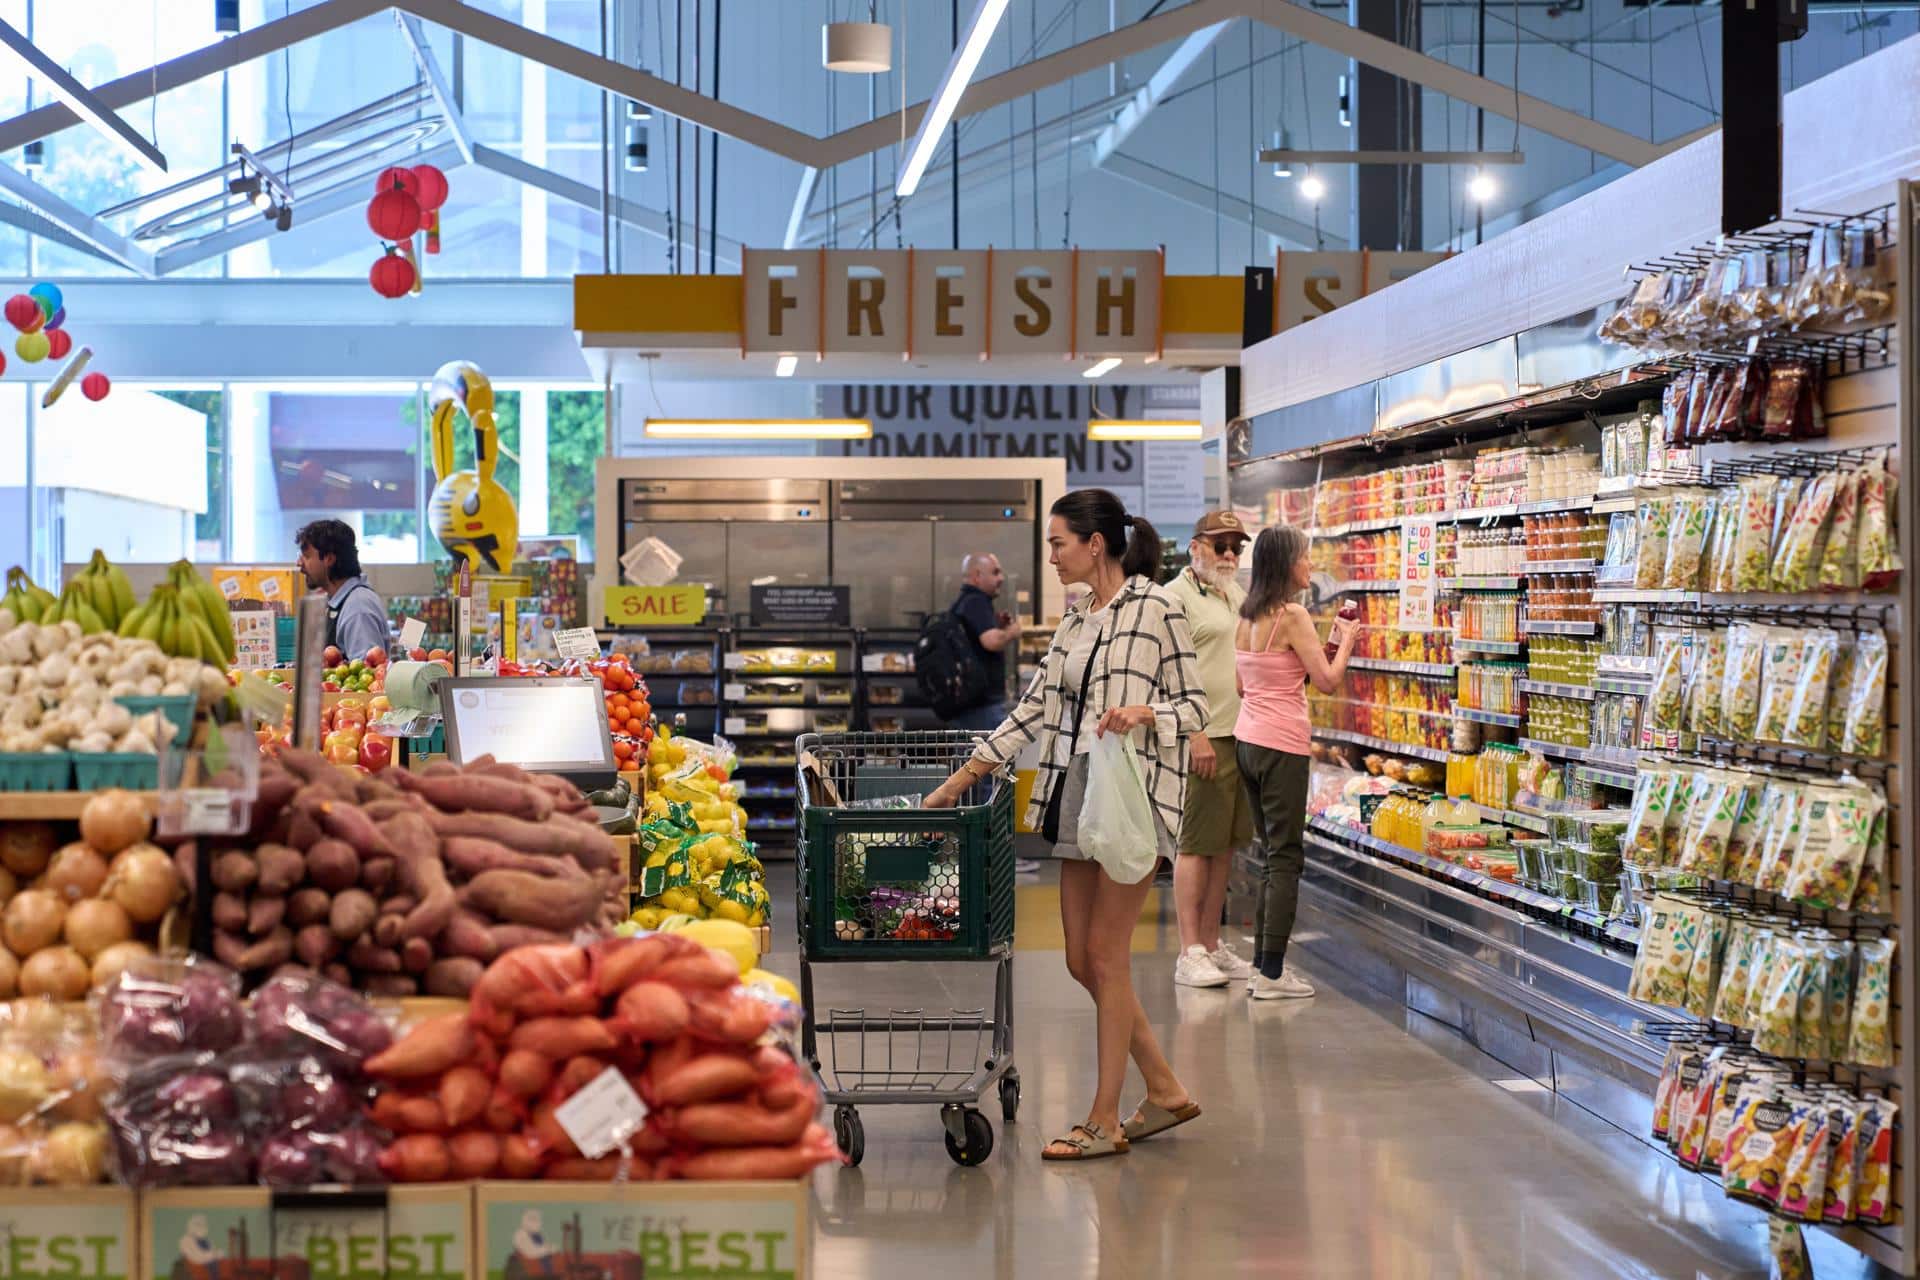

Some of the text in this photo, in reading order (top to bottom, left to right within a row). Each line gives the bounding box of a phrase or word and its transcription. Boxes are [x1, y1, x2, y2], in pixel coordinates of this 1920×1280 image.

[767, 264, 1136, 337] FRESH
[1254, 273, 1263, 290] 1
[843, 385, 932, 419] OUR
[1418, 526, 1431, 580] CLASS
[621, 593, 689, 617] SALE
[0, 1234, 118, 1276] EST
[306, 1233, 456, 1277] BEST
[638, 1231, 787, 1272] BEST
